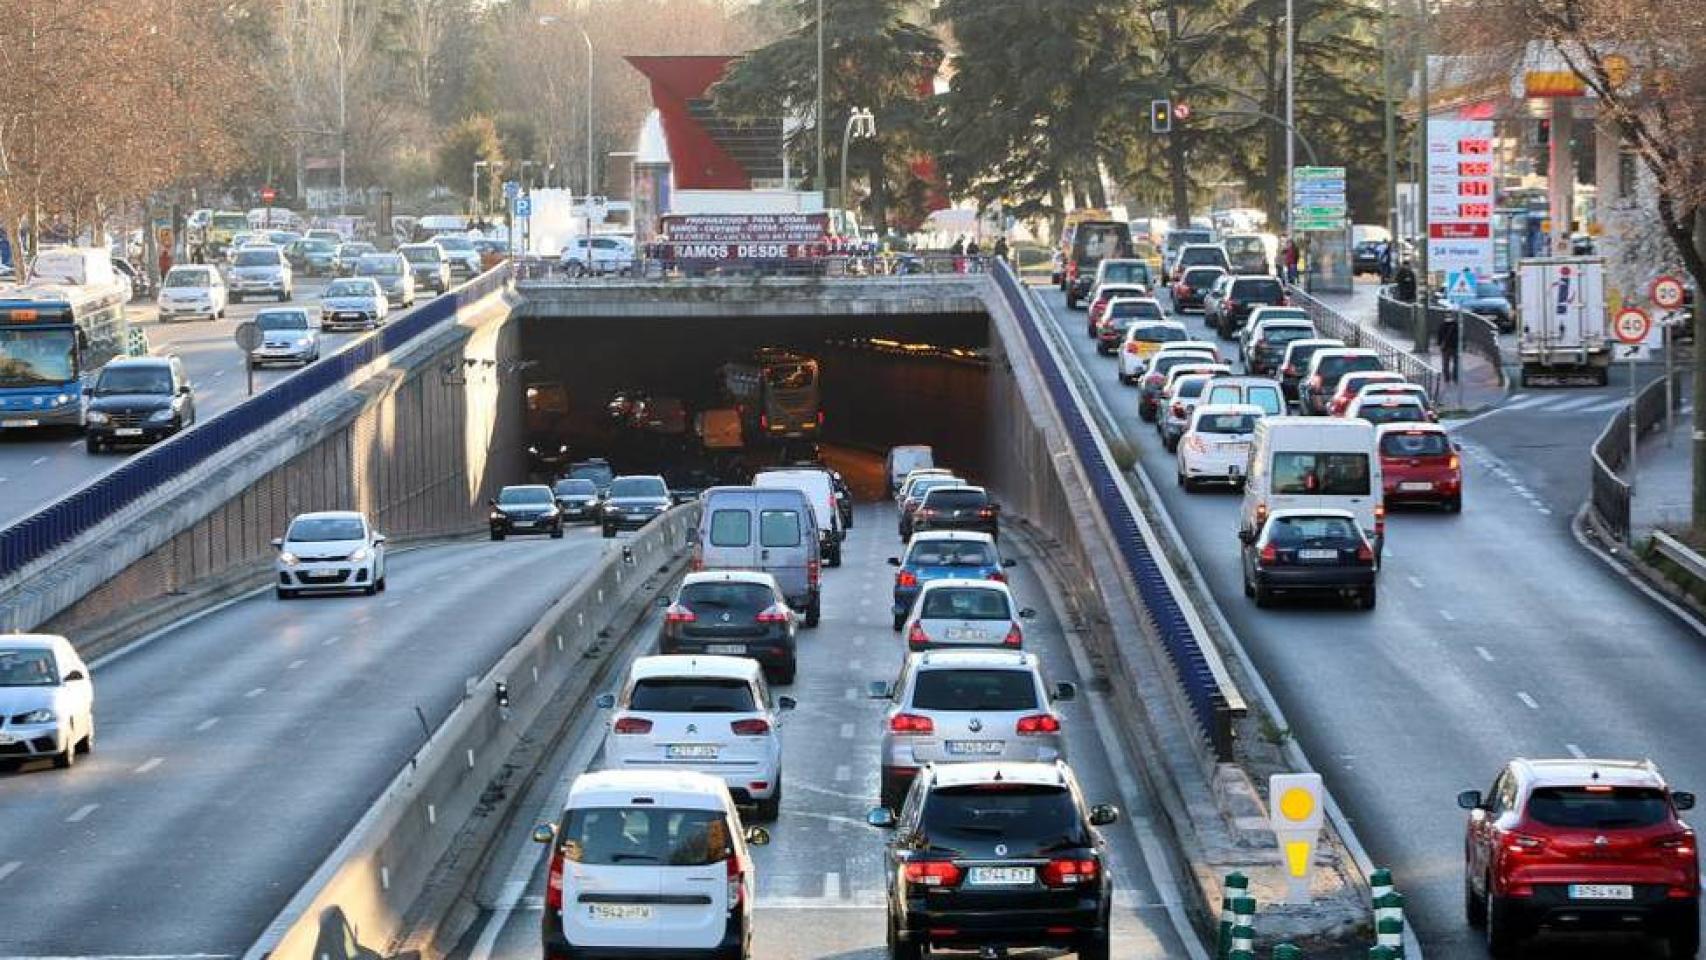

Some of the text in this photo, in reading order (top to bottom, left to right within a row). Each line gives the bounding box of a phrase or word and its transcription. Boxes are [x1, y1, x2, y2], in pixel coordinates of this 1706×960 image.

[517, 200, 529, 215] P
[673, 245, 729, 258] RAMOS
[738, 245, 789, 258] DESDE
[1622, 318, 1641, 331] 40
